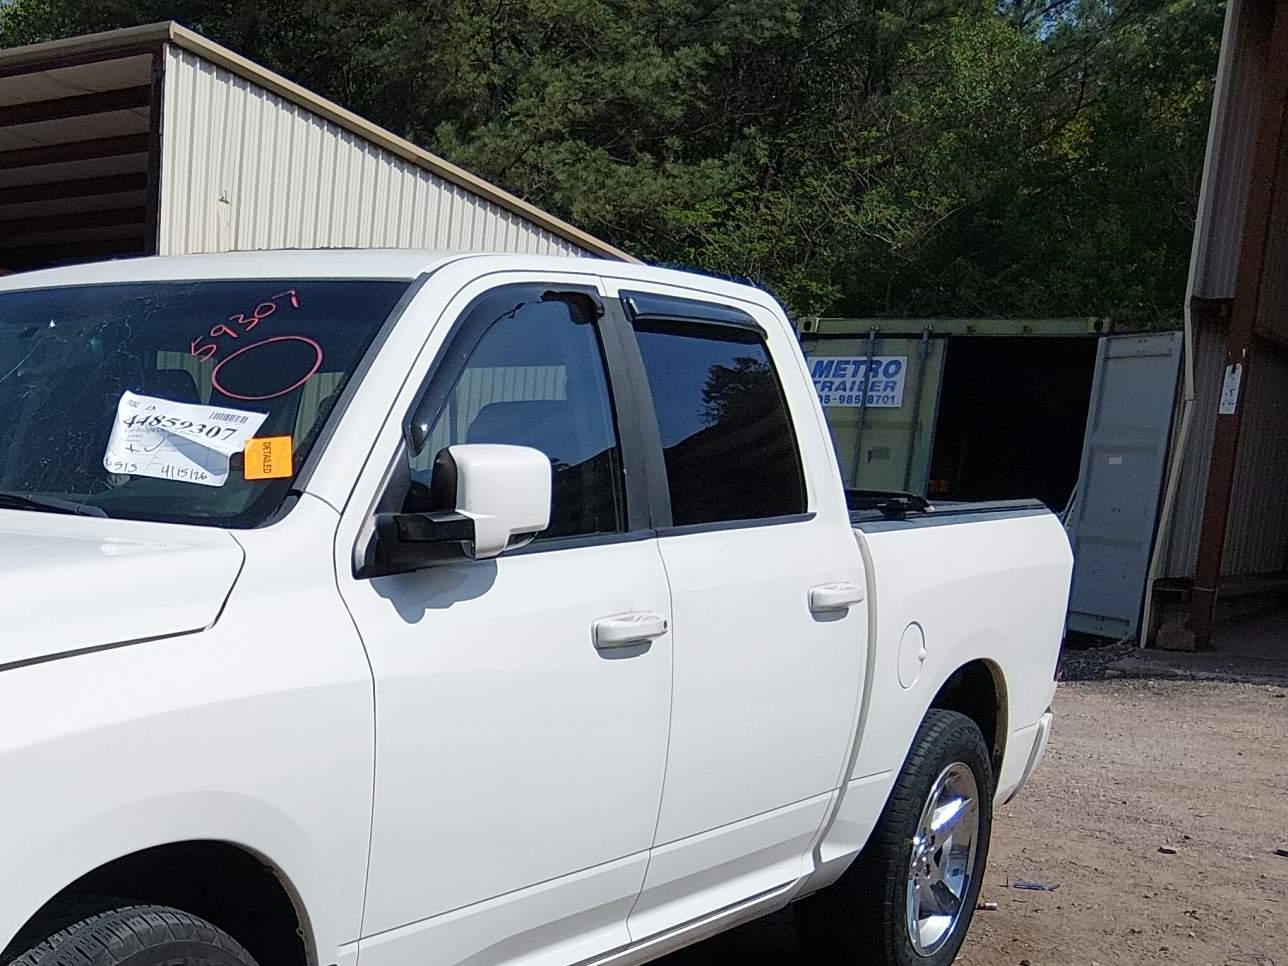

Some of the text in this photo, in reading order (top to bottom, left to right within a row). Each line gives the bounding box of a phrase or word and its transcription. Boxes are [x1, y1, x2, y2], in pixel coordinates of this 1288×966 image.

[190, 288, 300, 363] 59307
[812, 360, 901, 378] METRO
[813, 381, 897, 392] TRAILER
[123, 414, 238, 440] 44859307
[263, 442, 272, 473] DETAILED
